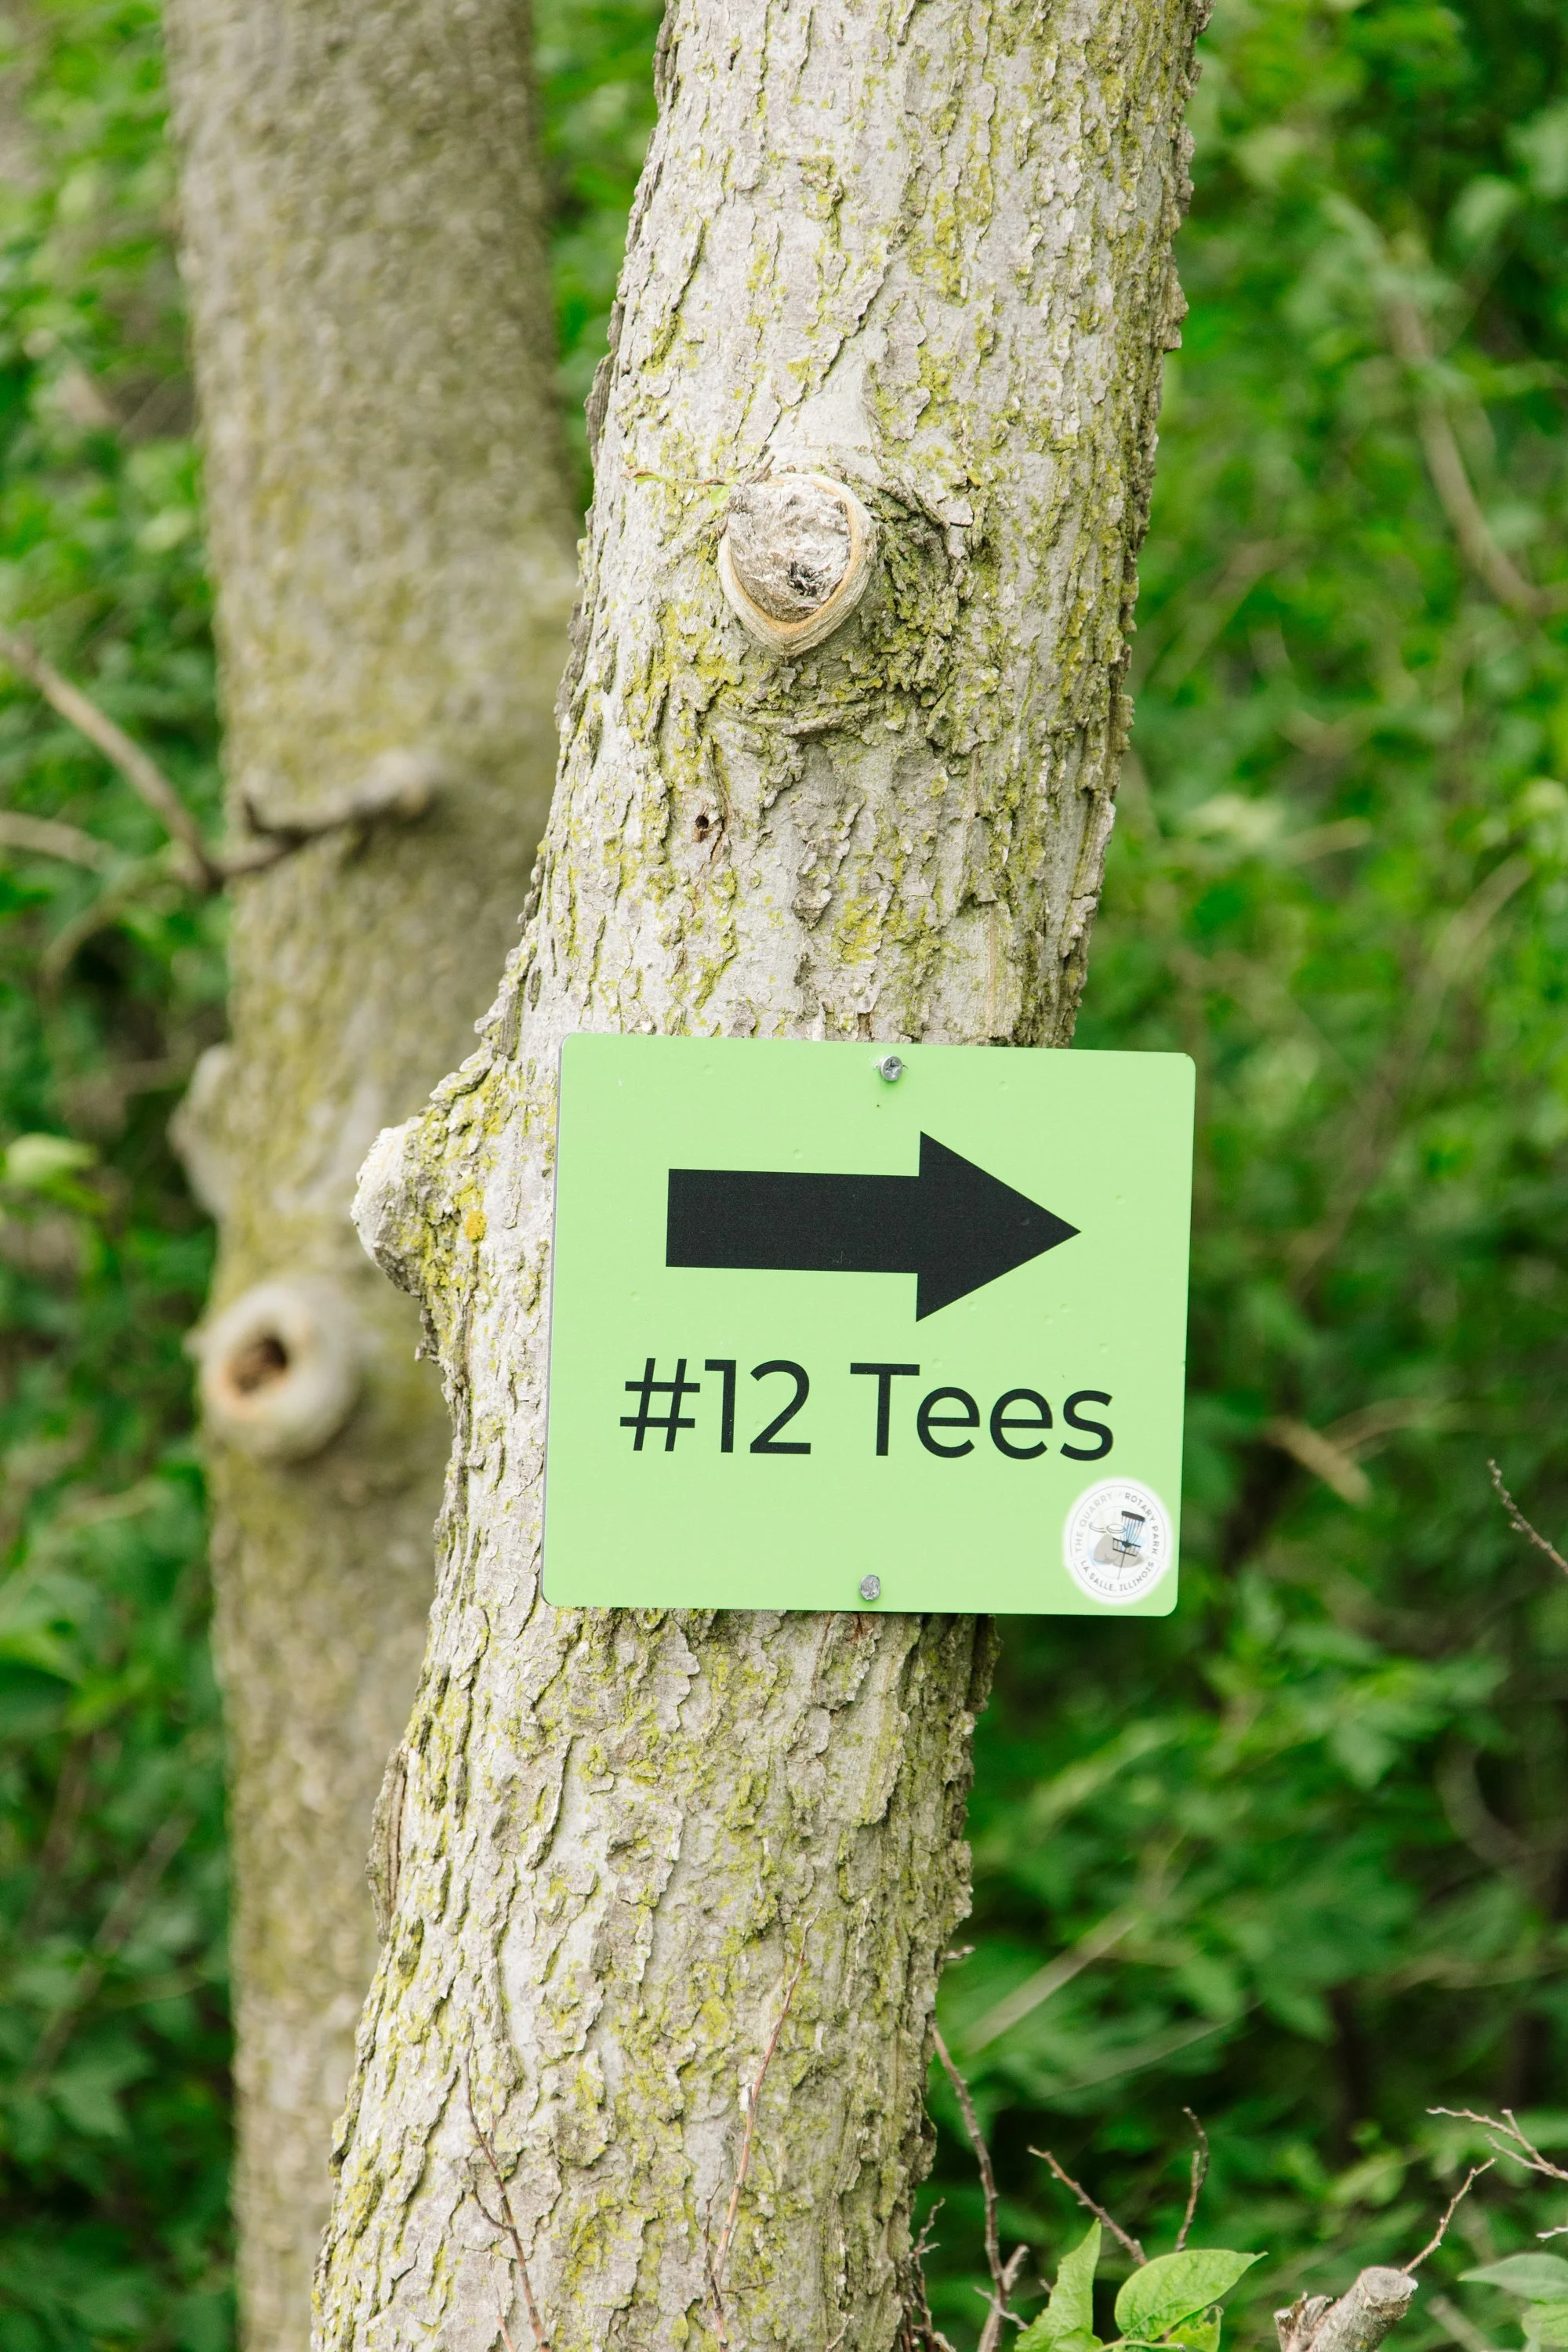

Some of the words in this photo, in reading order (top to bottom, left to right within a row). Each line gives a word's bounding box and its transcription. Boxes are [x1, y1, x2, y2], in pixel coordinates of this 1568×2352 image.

[619, 1357, 811, 1455] #12
[850, 1363, 1113, 1461] Tees
[1075, 1531, 1083, 1553] THE
[1080, 1492, 1112, 1527] QUARRY
[1124, 1492, 1156, 1523] ROTARY
[1151, 1526, 1160, 1555] PARK
[1080, 1560, 1089, 1573] LA
[1120, 1561, 1155, 1592] ILLINOIS
